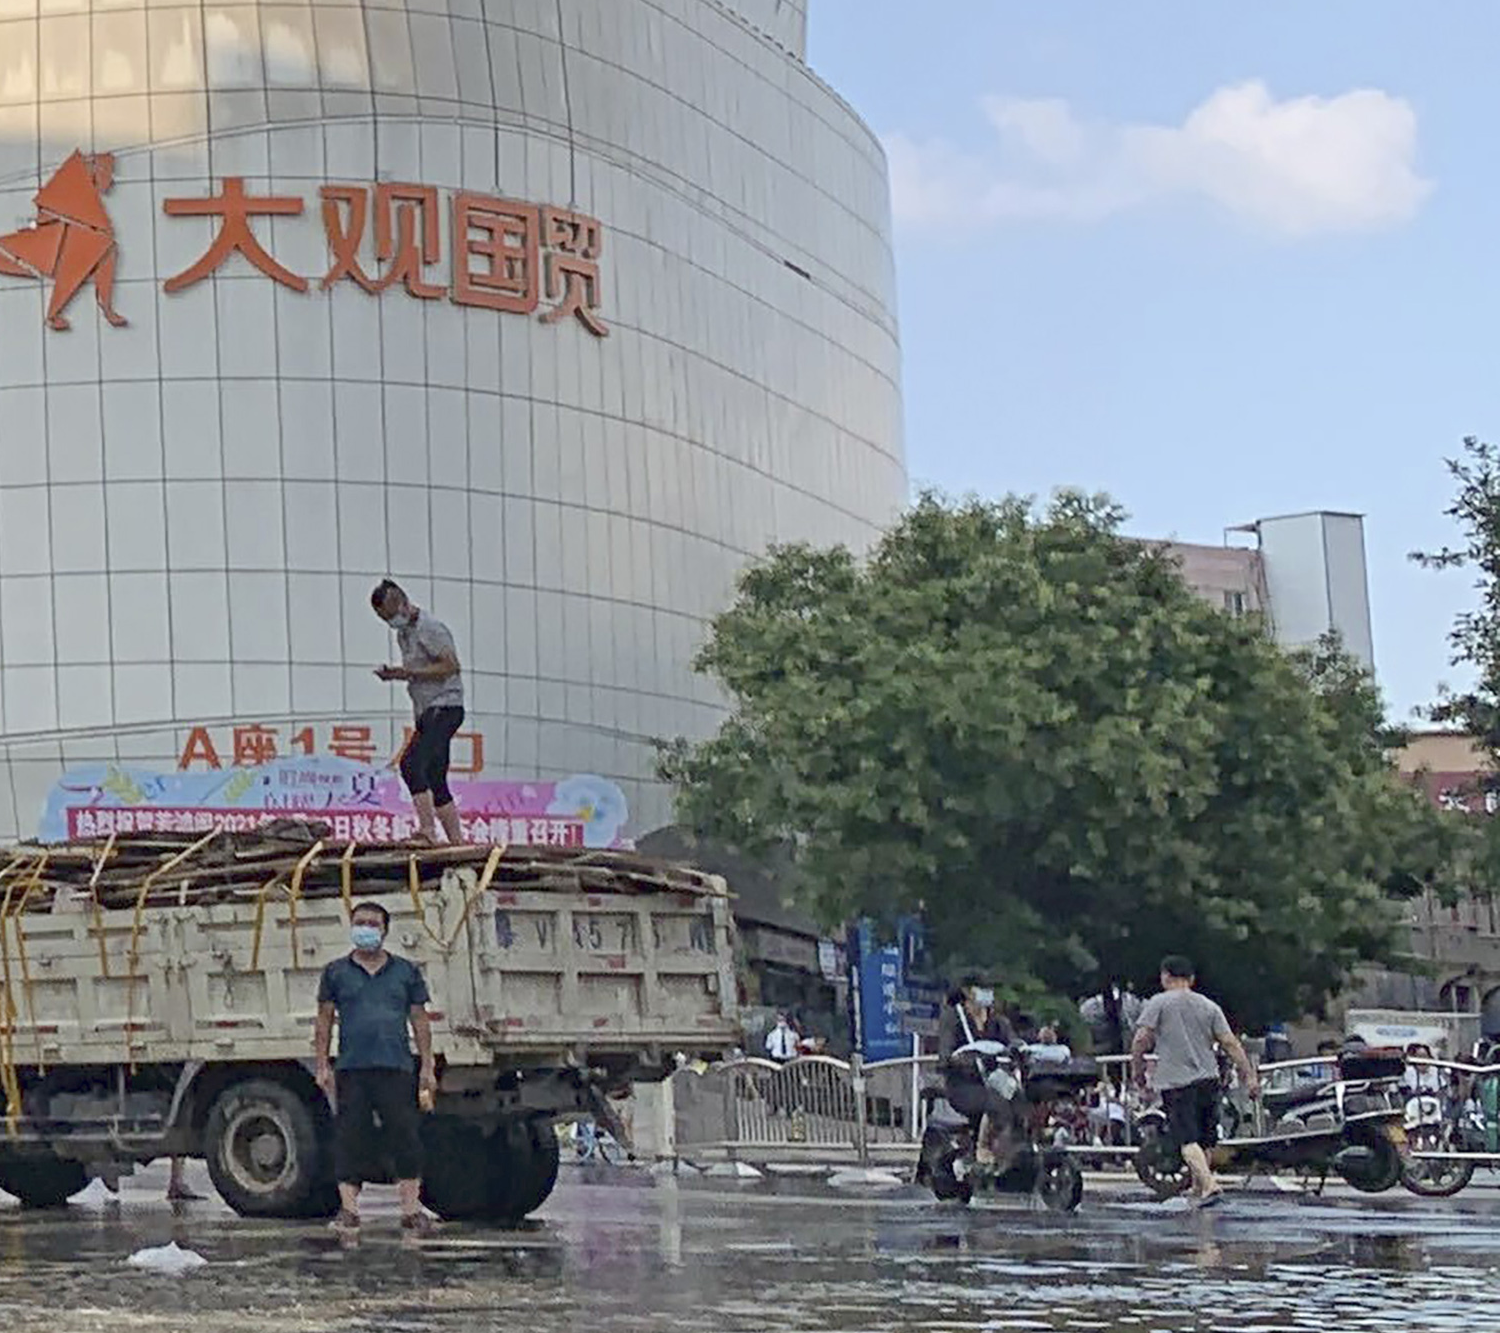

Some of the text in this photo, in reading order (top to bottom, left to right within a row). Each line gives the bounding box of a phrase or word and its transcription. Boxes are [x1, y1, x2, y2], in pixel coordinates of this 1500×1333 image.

[162, 176, 610, 338] 大观国贸
[176, 725, 484, 773] A座1号口
